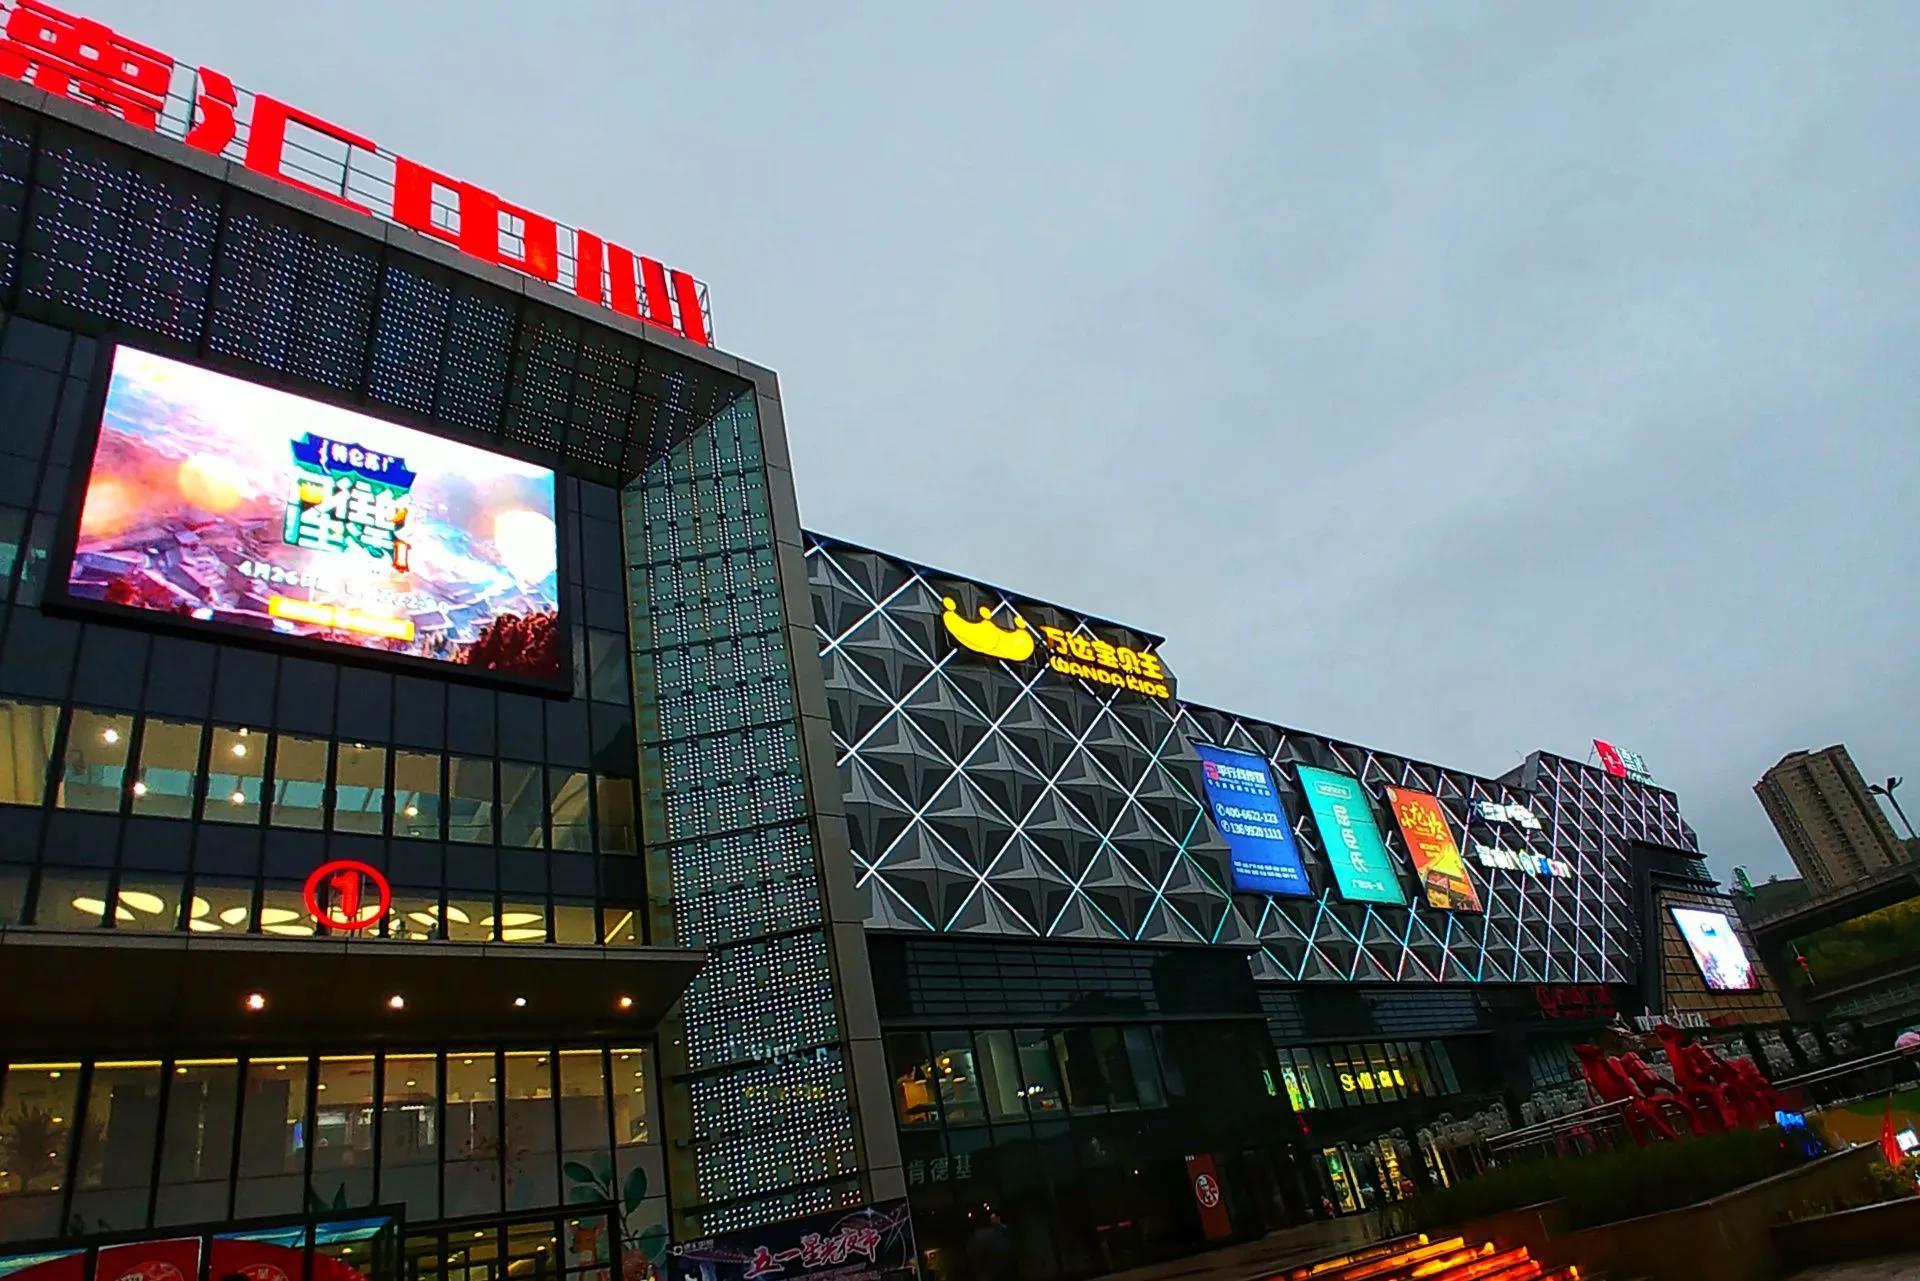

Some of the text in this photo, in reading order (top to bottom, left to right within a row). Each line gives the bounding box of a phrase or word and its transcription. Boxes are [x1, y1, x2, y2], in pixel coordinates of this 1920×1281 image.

[1039, 625, 1165, 680] 万达宝贝王
[1050, 655, 1170, 699] WANDA KIDS
[907, 1153, 974, 1186] 肯德基
[743, 1228, 881, 1280] 五一星光夜市
